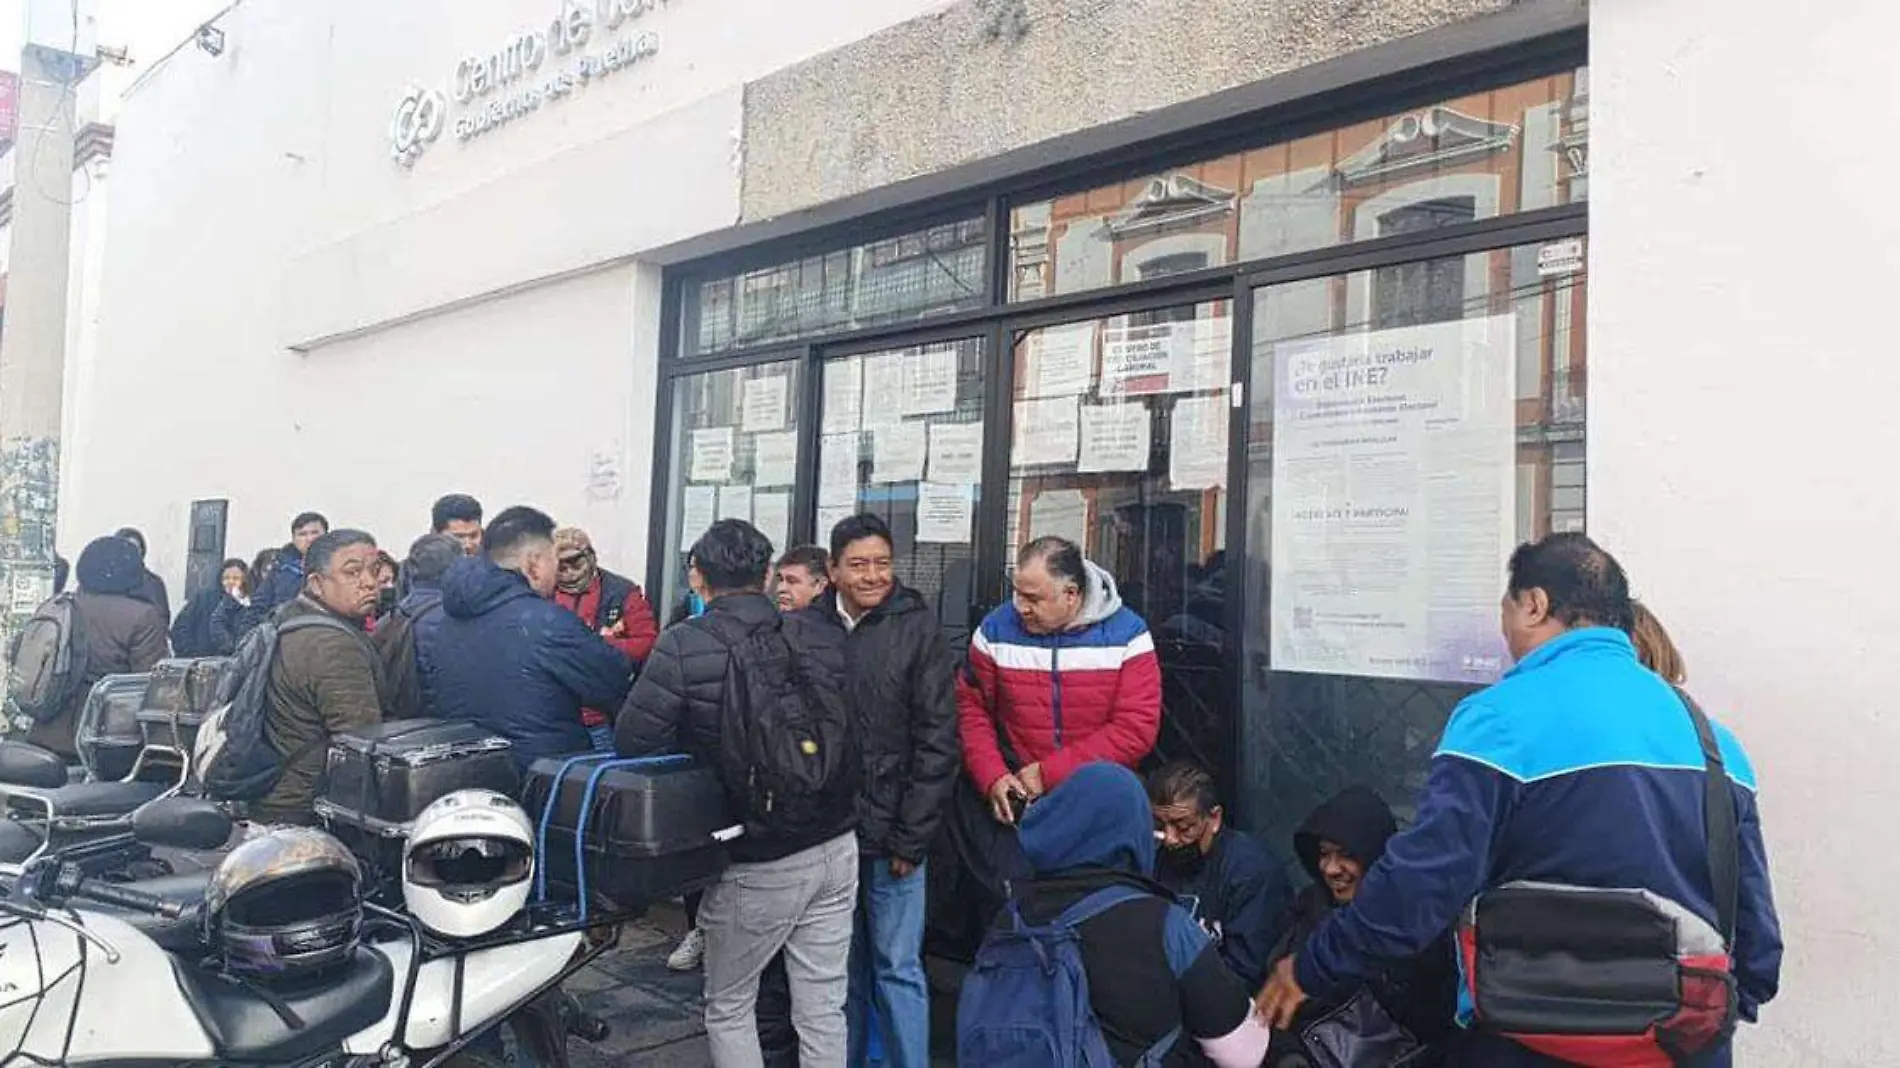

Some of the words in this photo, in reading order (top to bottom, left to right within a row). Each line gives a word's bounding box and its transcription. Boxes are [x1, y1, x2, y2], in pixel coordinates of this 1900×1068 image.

[452, 32, 546, 104] Centro
[549, 2, 593, 55] de
[1376, 347, 1433, 364] trabajar
[1294, 378, 1317, 393] en
[1323, 371, 1340, 390] el
[1345, 366, 1388, 388] INE?
